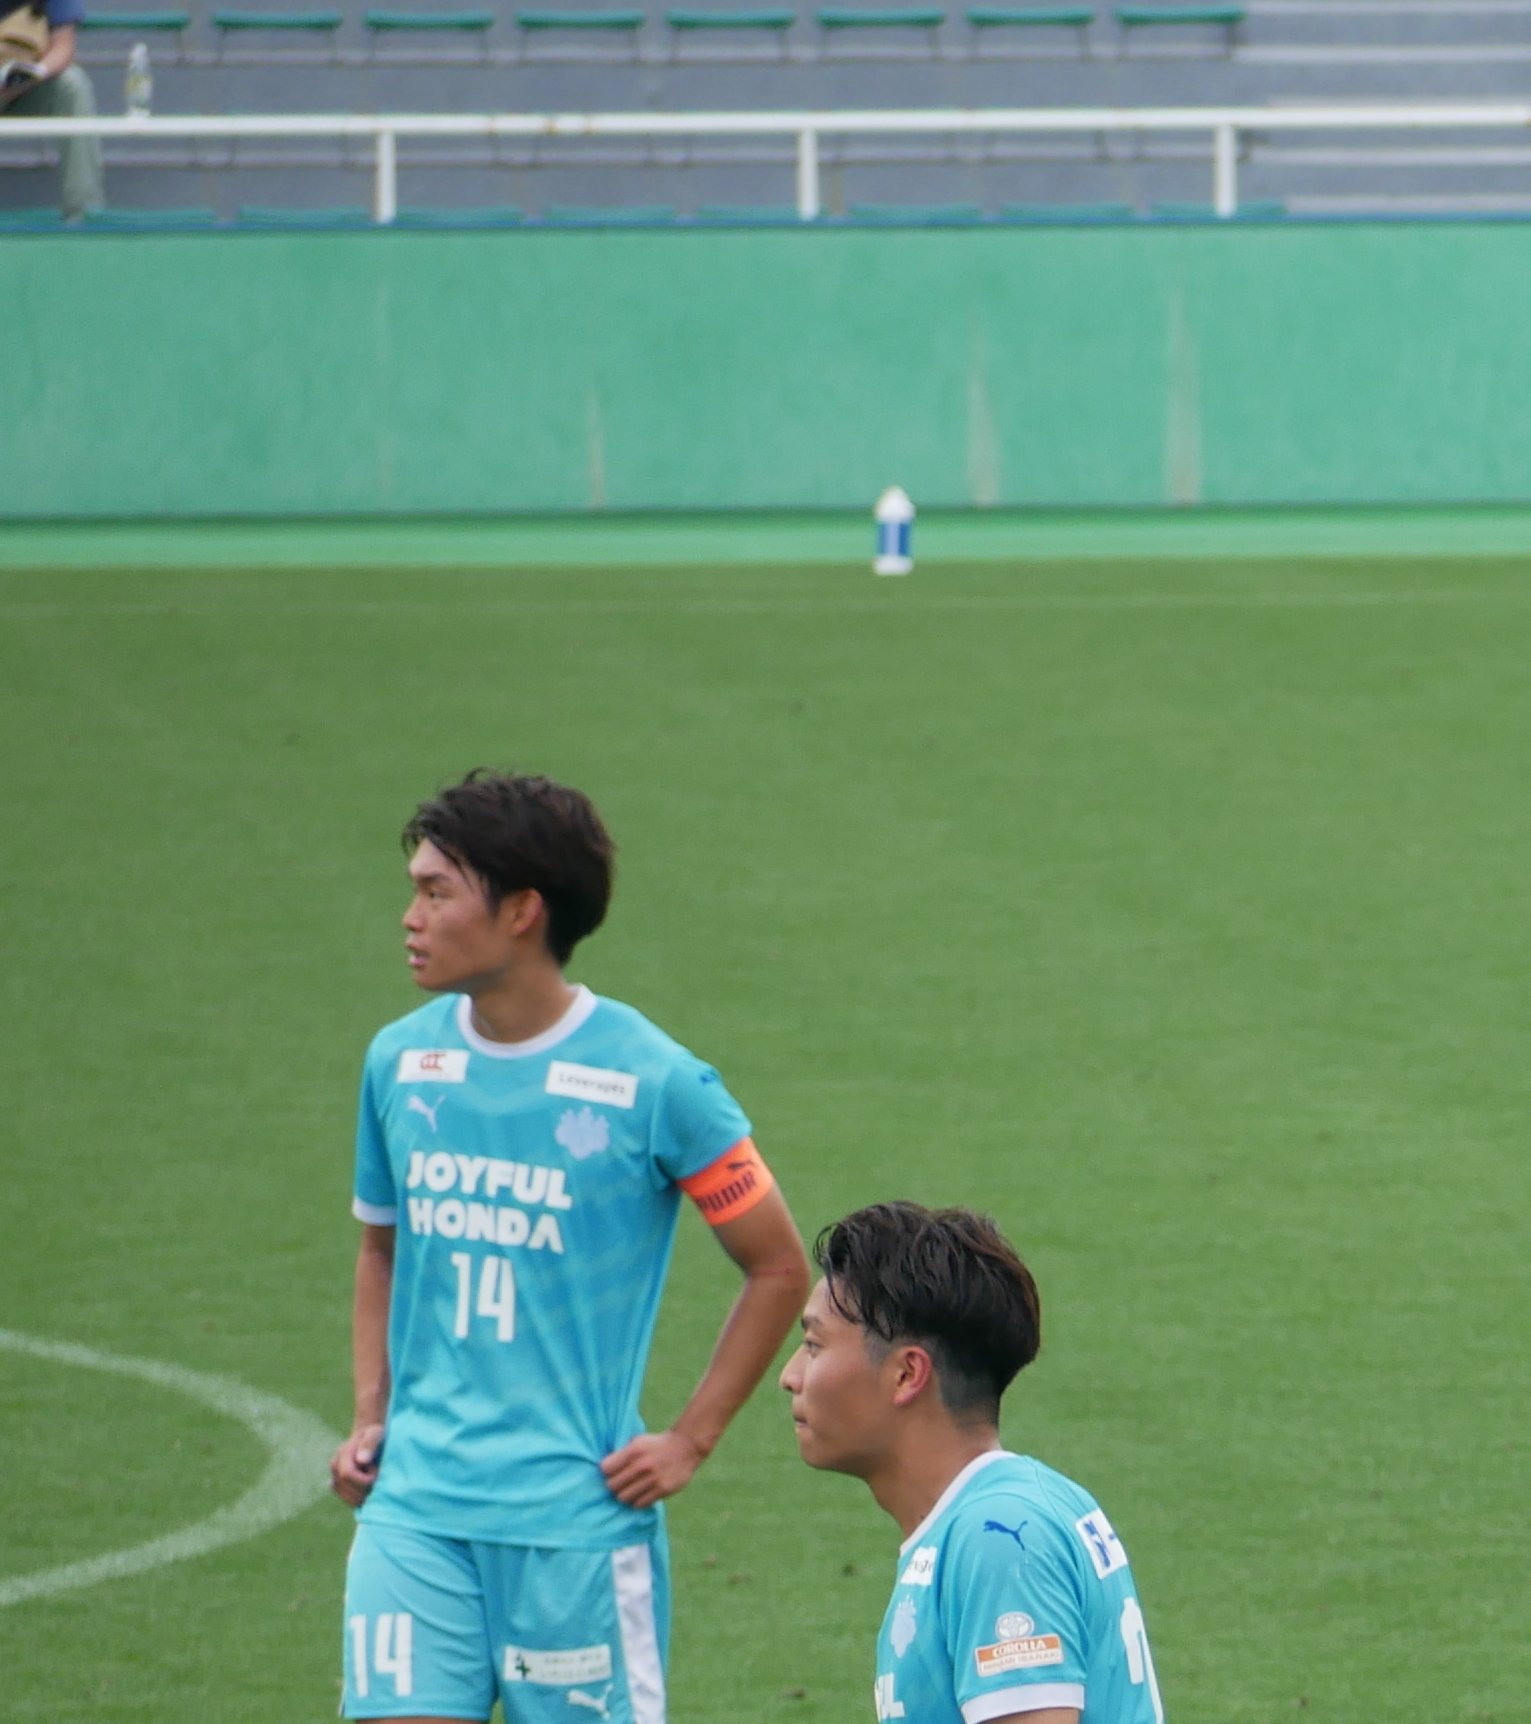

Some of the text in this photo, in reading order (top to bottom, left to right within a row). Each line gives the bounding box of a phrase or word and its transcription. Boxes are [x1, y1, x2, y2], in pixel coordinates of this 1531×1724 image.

[406, 1151, 573, 1211] JOYFUL
[407, 1196, 565, 1255] HONDA
[451, 1252, 516, 1344] 14
[349, 1612, 413, 1698] 14
[991, 1638, 1048, 1659] COROLLA
